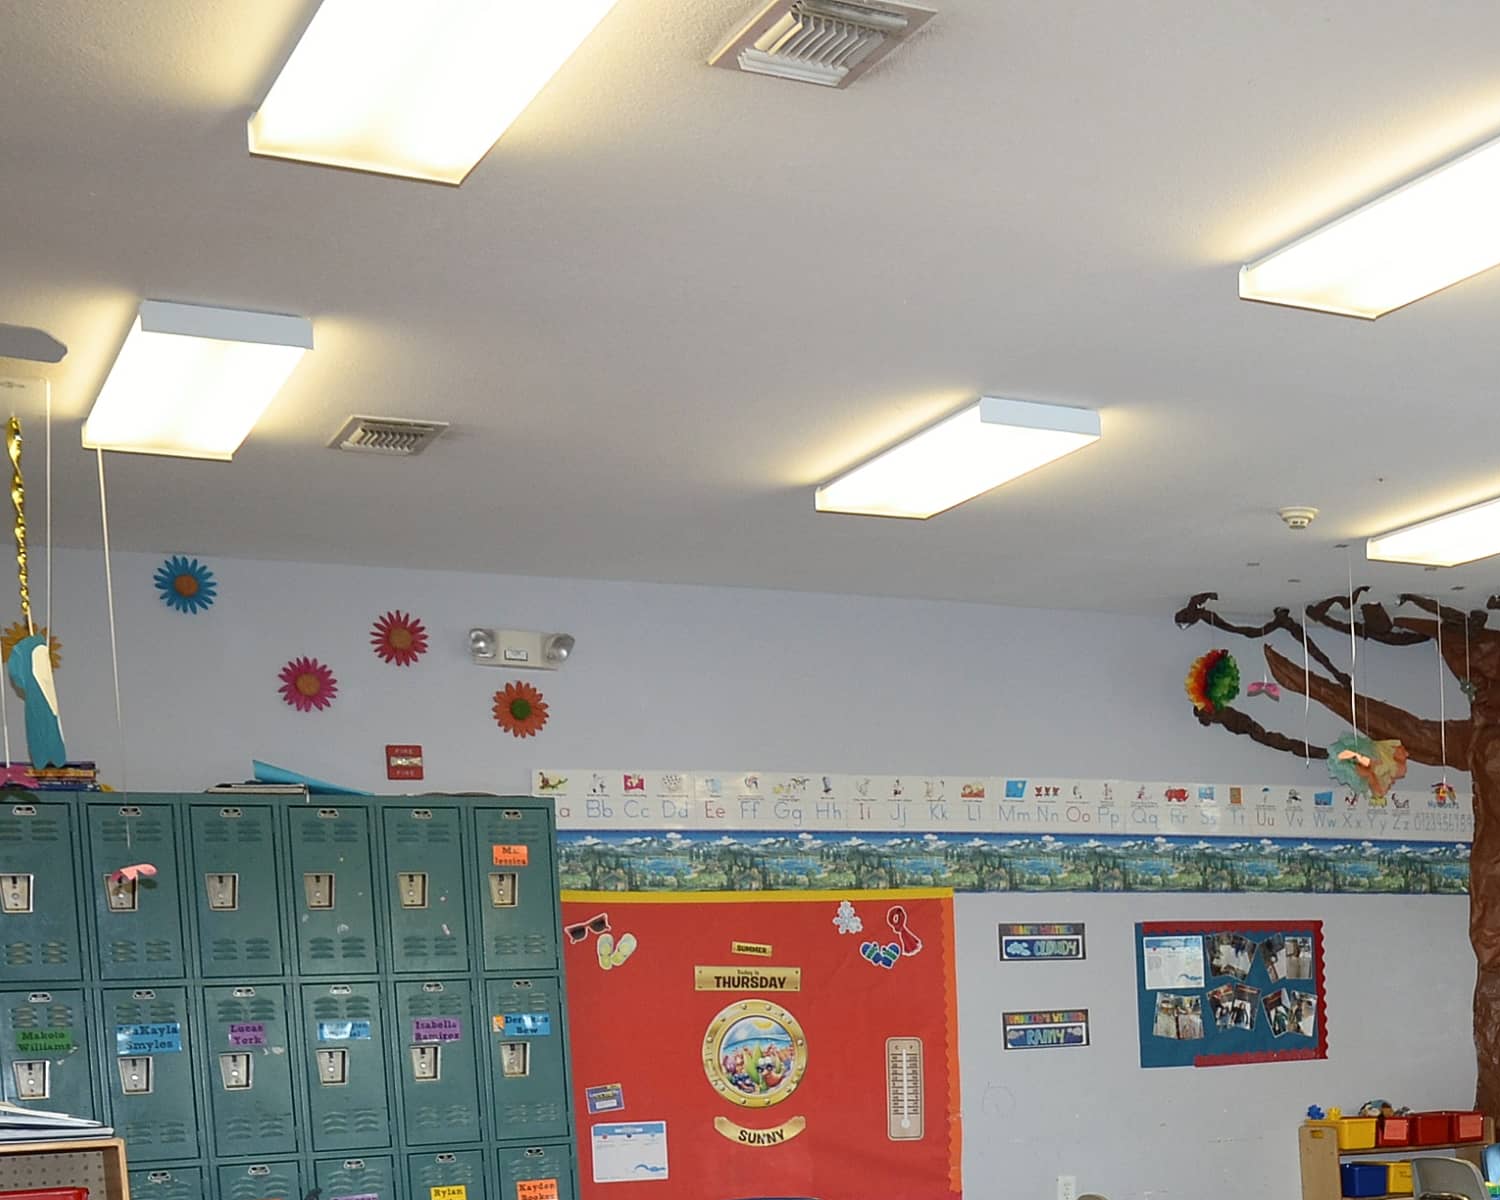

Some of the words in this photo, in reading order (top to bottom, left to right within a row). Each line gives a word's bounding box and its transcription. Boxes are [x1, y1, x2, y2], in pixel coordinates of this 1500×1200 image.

[585, 800, 614, 819] Bb
[623, 800, 649, 819] Cc
[662, 800, 689, 819] Dd
[705, 800, 726, 820] Ee
[740, 800, 759, 820] Ff
[773, 803, 803, 827] Gg
[816, 802, 843, 821] Hh
[889, 804, 907, 828] Jj
[929, 802, 949, 822] Kk
[999, 805, 1031, 823] Mm
[1036, 807, 1059, 823] Nn
[1065, 806, 1092, 824] Oo
[1097, 807, 1120, 829] Pp
[1131, 807, 1158, 831] Qq
[1256, 809, 1275, 827] Uu
[1285, 810, 1304, 828] Vv
[1312, 812, 1337, 829] Ww
[1342, 813, 1362, 831] Xx
[1367, 813, 1386, 835] Yy
[714, 975, 787, 989] THURSDAY
[229, 1024, 264, 1034] Lucas
[415, 1021, 457, 1030] Isabella
[233, 1035, 263, 1046] York
[1025, 1028, 1066, 1045] RAINY
[18, 1041, 72, 1052] Williams
[738, 1128, 785, 1145] SUNNY
[433, 1187, 464, 1198] Rylan
